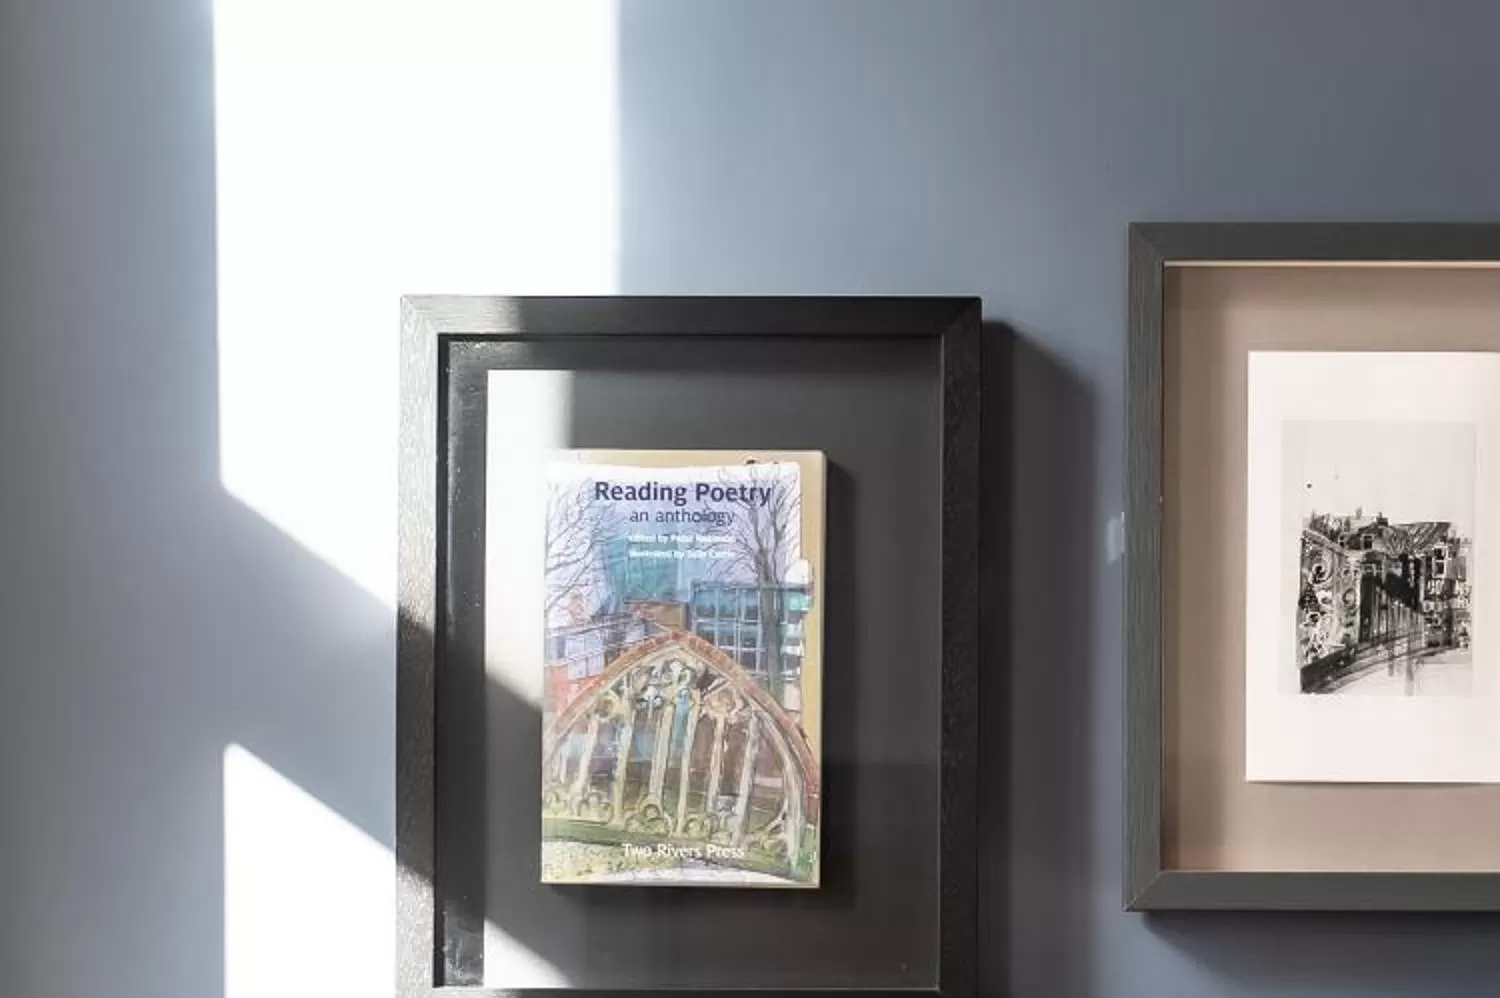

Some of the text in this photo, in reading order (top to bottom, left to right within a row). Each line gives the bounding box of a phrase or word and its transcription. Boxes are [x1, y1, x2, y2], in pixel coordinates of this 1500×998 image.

[594, 481, 772, 507] Reading Poetry
[629, 508, 735, 527] an anthology
[622, 843, 745, 858] Two Rivers Press
